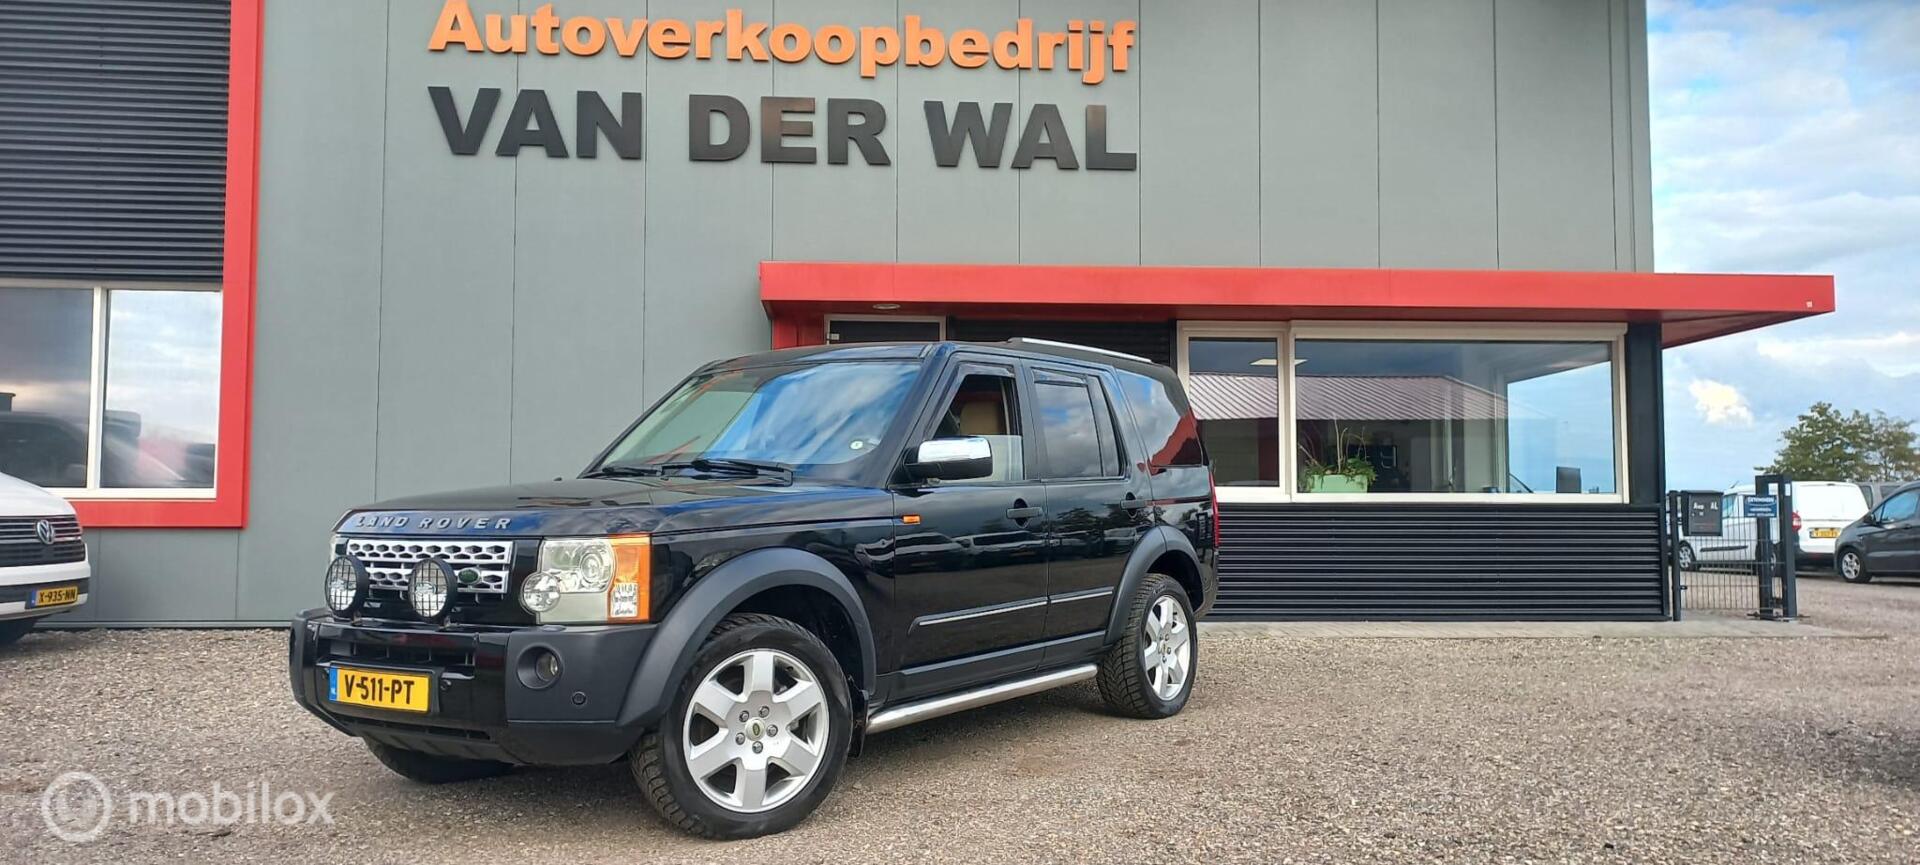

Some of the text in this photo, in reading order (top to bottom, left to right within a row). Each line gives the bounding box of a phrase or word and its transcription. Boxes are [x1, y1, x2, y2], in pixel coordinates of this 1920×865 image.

[427, 0, 1137, 84] Autoverkoopbedrijf
[428, 86, 1138, 171] VAN DER WAL
[356, 516, 512, 530] LAND ROVER
[38, 588, 76, 604] X-935-NN
[344, 674, 415, 705] V-511-PT
